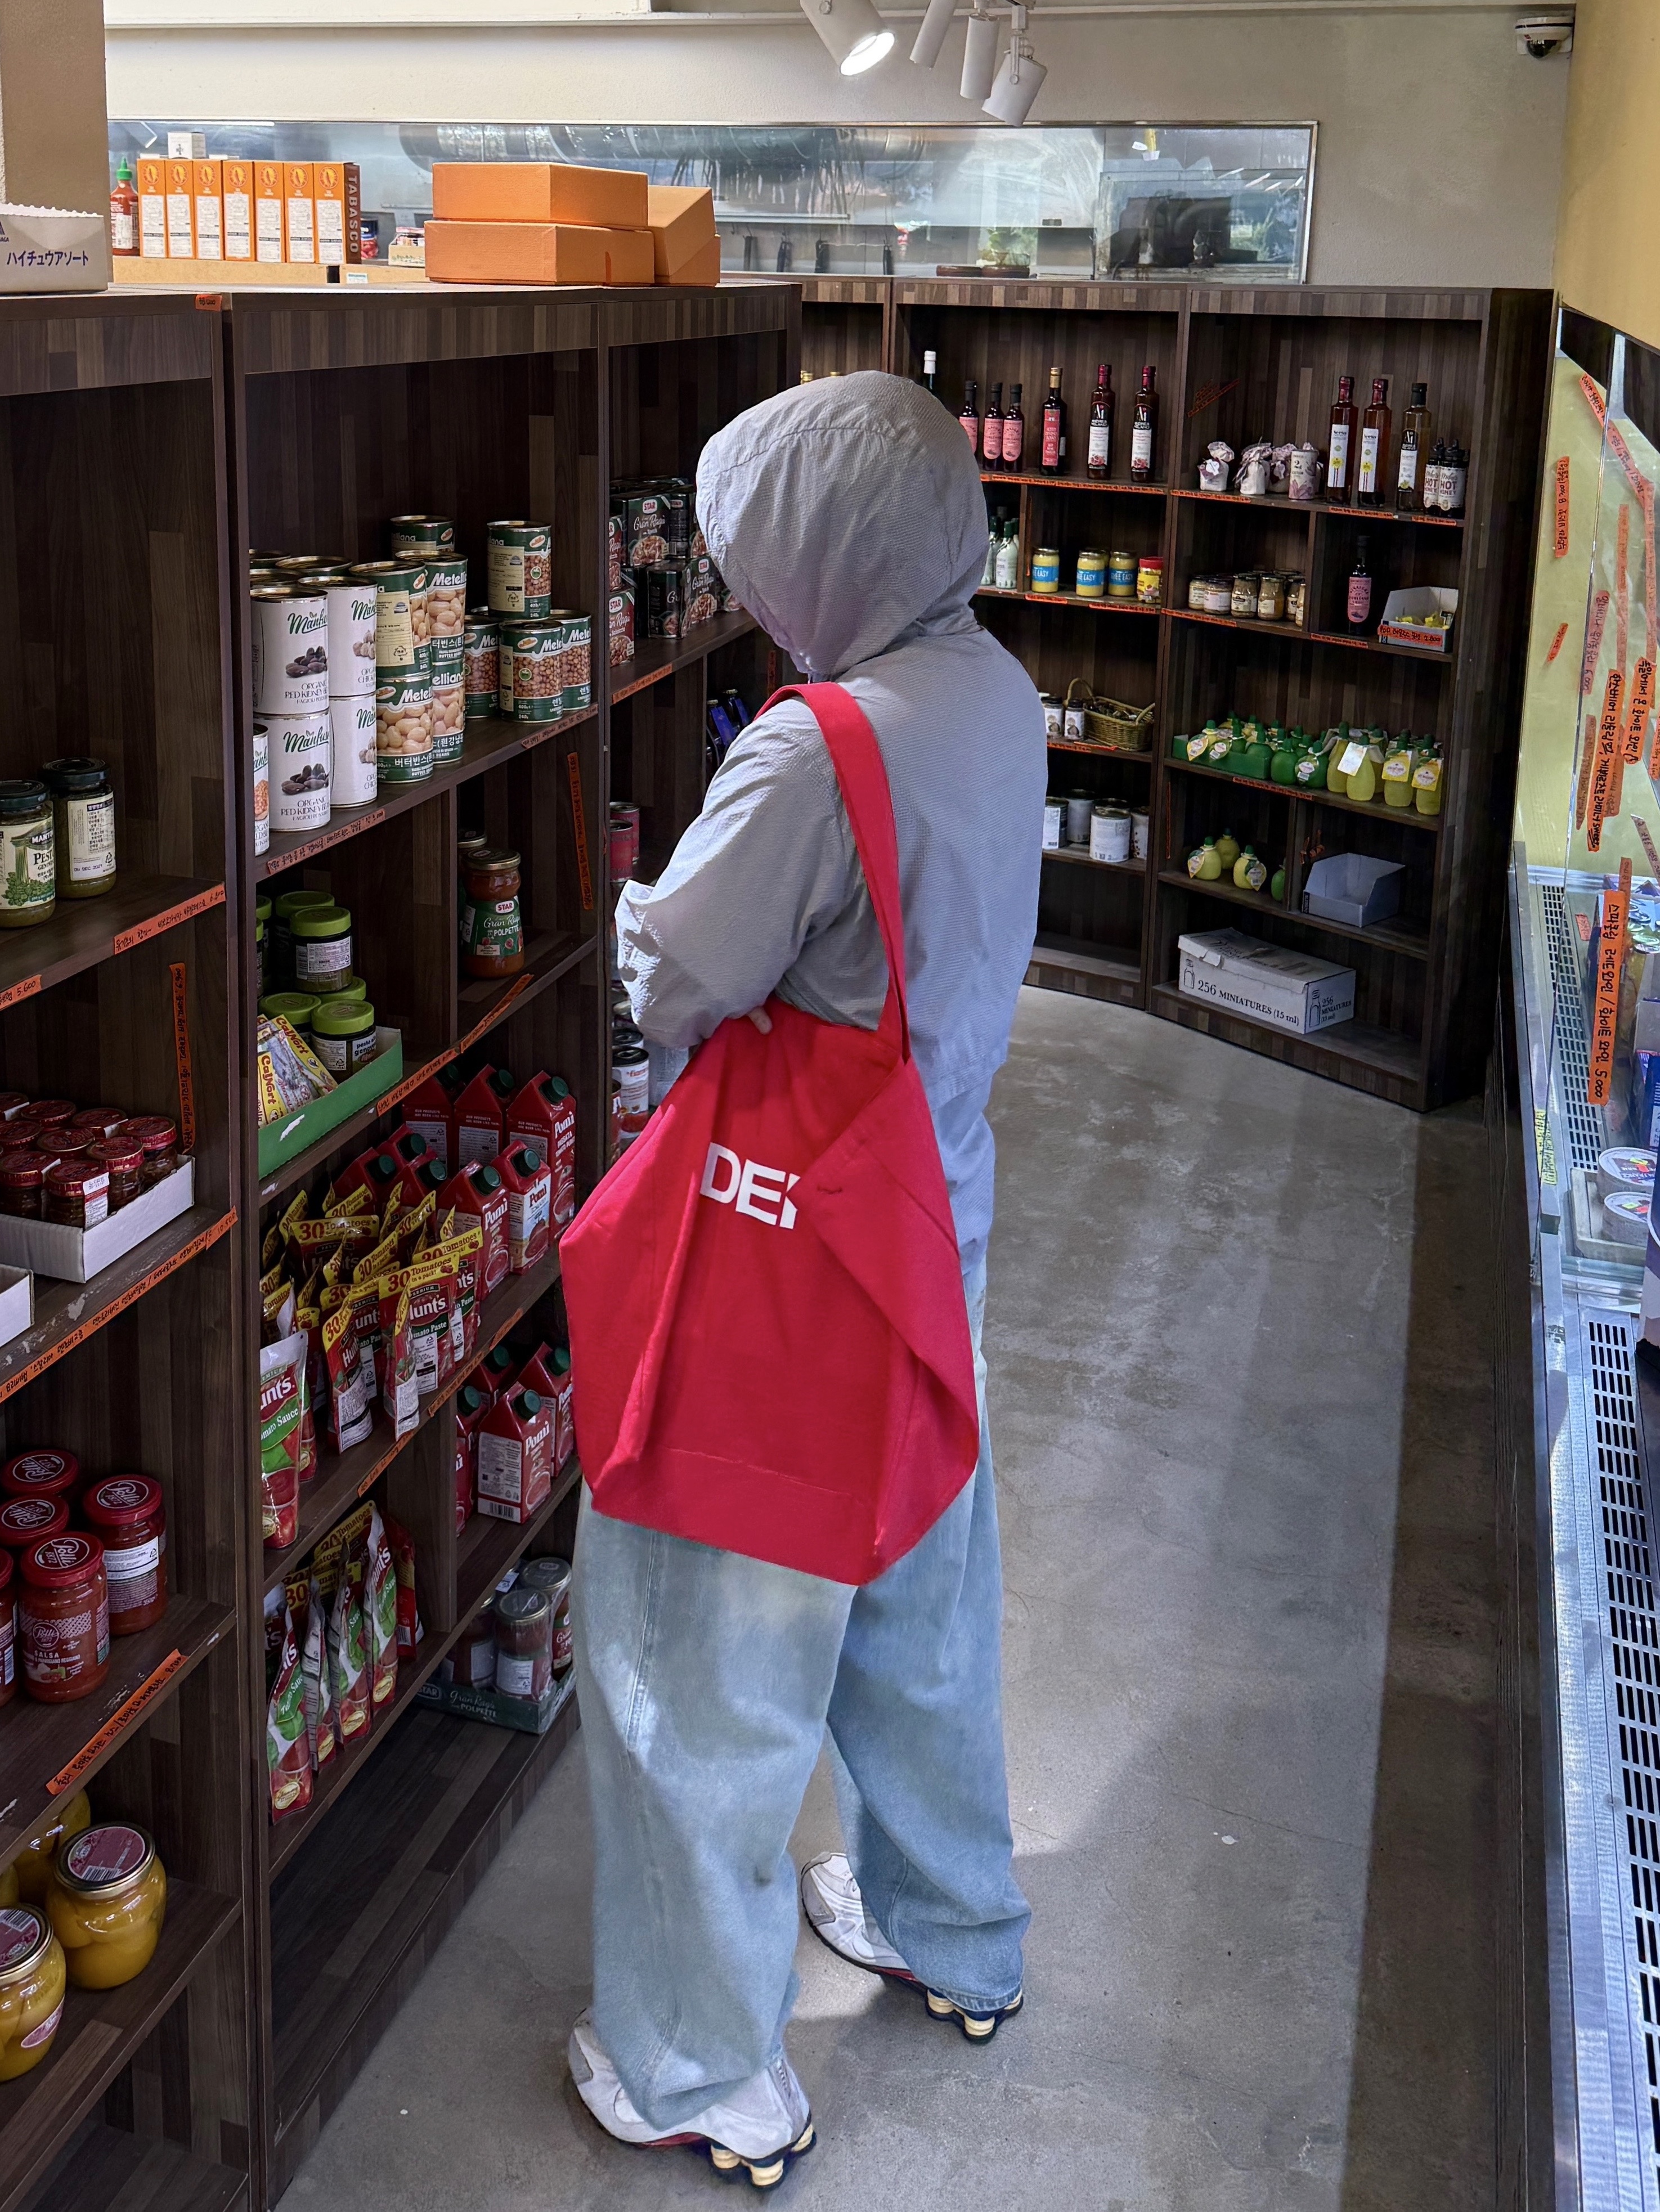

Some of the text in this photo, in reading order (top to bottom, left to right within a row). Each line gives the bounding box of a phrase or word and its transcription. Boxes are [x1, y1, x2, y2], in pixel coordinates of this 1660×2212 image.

[348, 176, 359, 253] TABASCO
[7, 250, 88, 267] ハイチュウアソート
[1441, 481, 1457, 490] HOT
[644, 501, 656, 510] STAR
[1037, 568, 1049, 577] EASY
[1083, 573, 1096, 581] EASY
[610, 599, 621, 609] STAR
[1638, 660, 1653, 696] 독일에서
[1630, 707, 1645, 732] 화이트
[1626, 734, 1640, 753] 와인
[281, 807, 297, 816] RED
[497, 902, 513, 911] STAR
[483, 917, 505, 928] Gran
[17, 980, 37, 997] 5.600
[1198, 980, 1300, 1026] 256 MINIATURES (15 ml)
[1322, 995, 1334, 1007] 256
[1598, 1007, 1615, 1038] 화이트
[356, 1039, 371, 1049] pesto
[1595, 1039, 1611, 1063] 와인
[299, 1218, 370, 1241] 30 Tomatoes
[398, 1217, 411, 1237] 30
[442, 1232, 477, 1254] Tomatoes
[358, 1237, 394, 1282] 30 Tomatoes
[388, 1256, 452, 1293] 30 Tomatoes
[423, 1270, 437, 1280] pack!
[457, 1270, 474, 1289] nt's
[461, 1294, 474, 1308] Paste
[325, 1316, 342, 1343] 30
[414, 1321, 447, 1339] mato Paste
[261, 1375, 292, 1411] unt's
[261, 1407, 299, 1441] omato Sauce
[22, 1456, 56, 1481] Polli
[106, 1482, 141, 1506] Polli
[8, 1505, 52, 1527] Polli
[45, 1550, 57, 1564] 1872
[51, 1539, 79, 1567] Polli
[34, 1650, 60, 1658] SALSA
